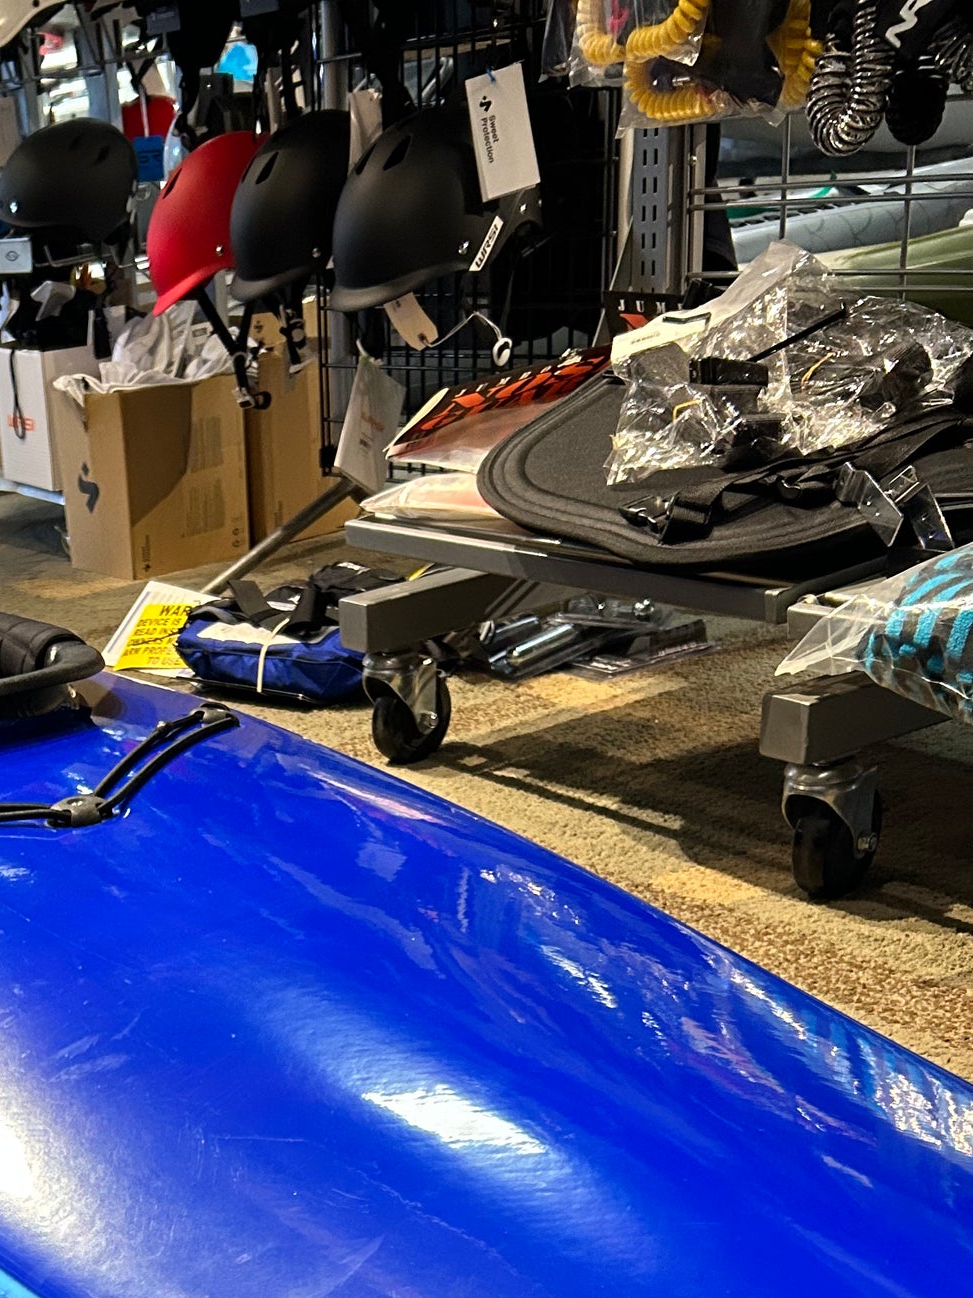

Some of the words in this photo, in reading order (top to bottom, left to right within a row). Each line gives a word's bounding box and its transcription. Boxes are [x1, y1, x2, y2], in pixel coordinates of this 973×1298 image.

[481, 117, 495, 164] Protection
[489, 115, 500, 143] Sweet
[475, 224, 499, 268] WRSI
[134, 628, 157, 636] READ
[137, 618, 170, 628] DEVICE
[171, 618, 182, 626] IS
